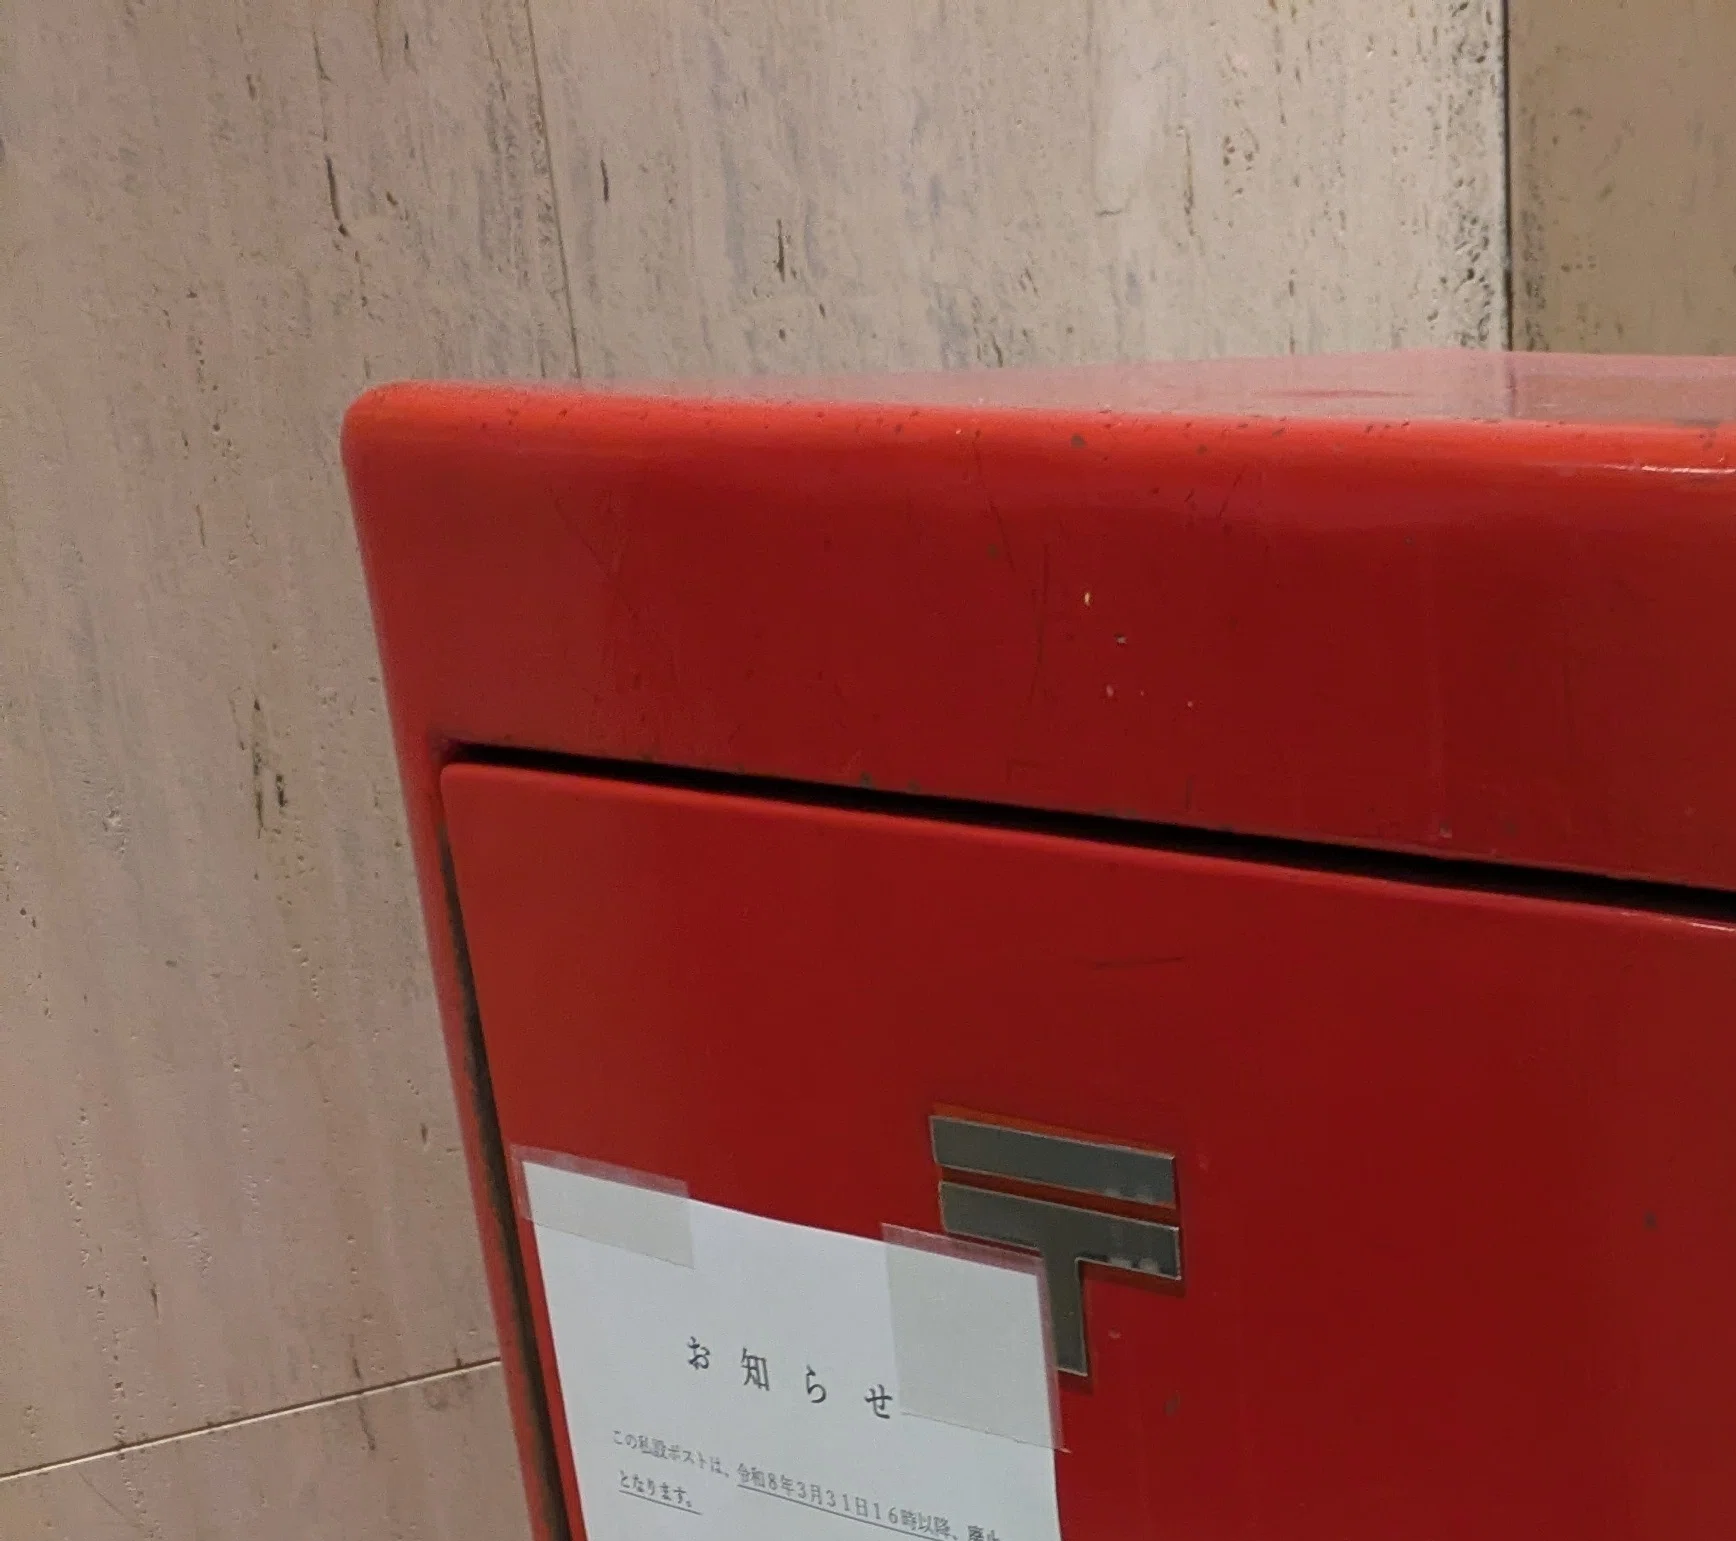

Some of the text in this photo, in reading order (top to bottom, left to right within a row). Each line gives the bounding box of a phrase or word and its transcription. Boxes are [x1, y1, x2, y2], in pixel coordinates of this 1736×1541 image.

[687, 1336, 893, 1419] お知らせ
[619, 1470, 694, 1509] となります。
